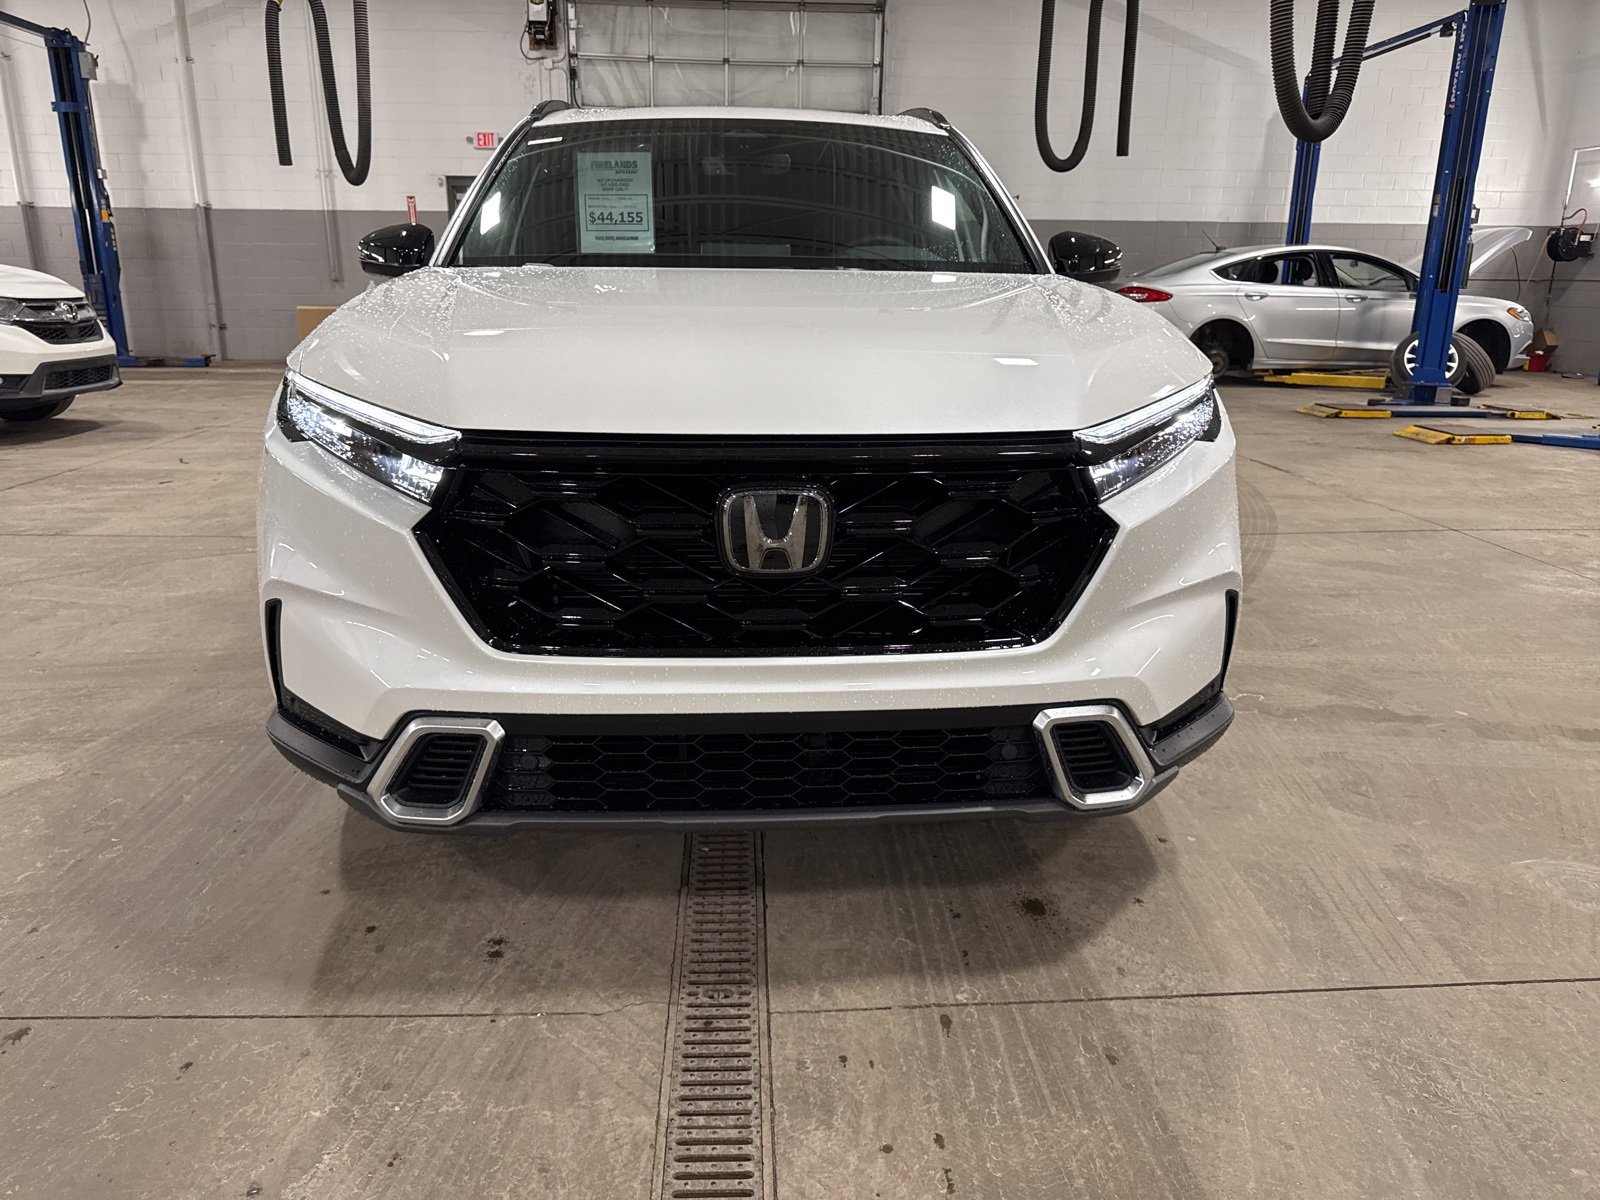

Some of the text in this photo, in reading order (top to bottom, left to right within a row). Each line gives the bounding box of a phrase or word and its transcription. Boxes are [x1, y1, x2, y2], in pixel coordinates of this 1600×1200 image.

[477, 132, 494, 147] EXIT
[591, 160, 638, 169] FIRELANDS
[589, 211, 643, 225] $44,155
